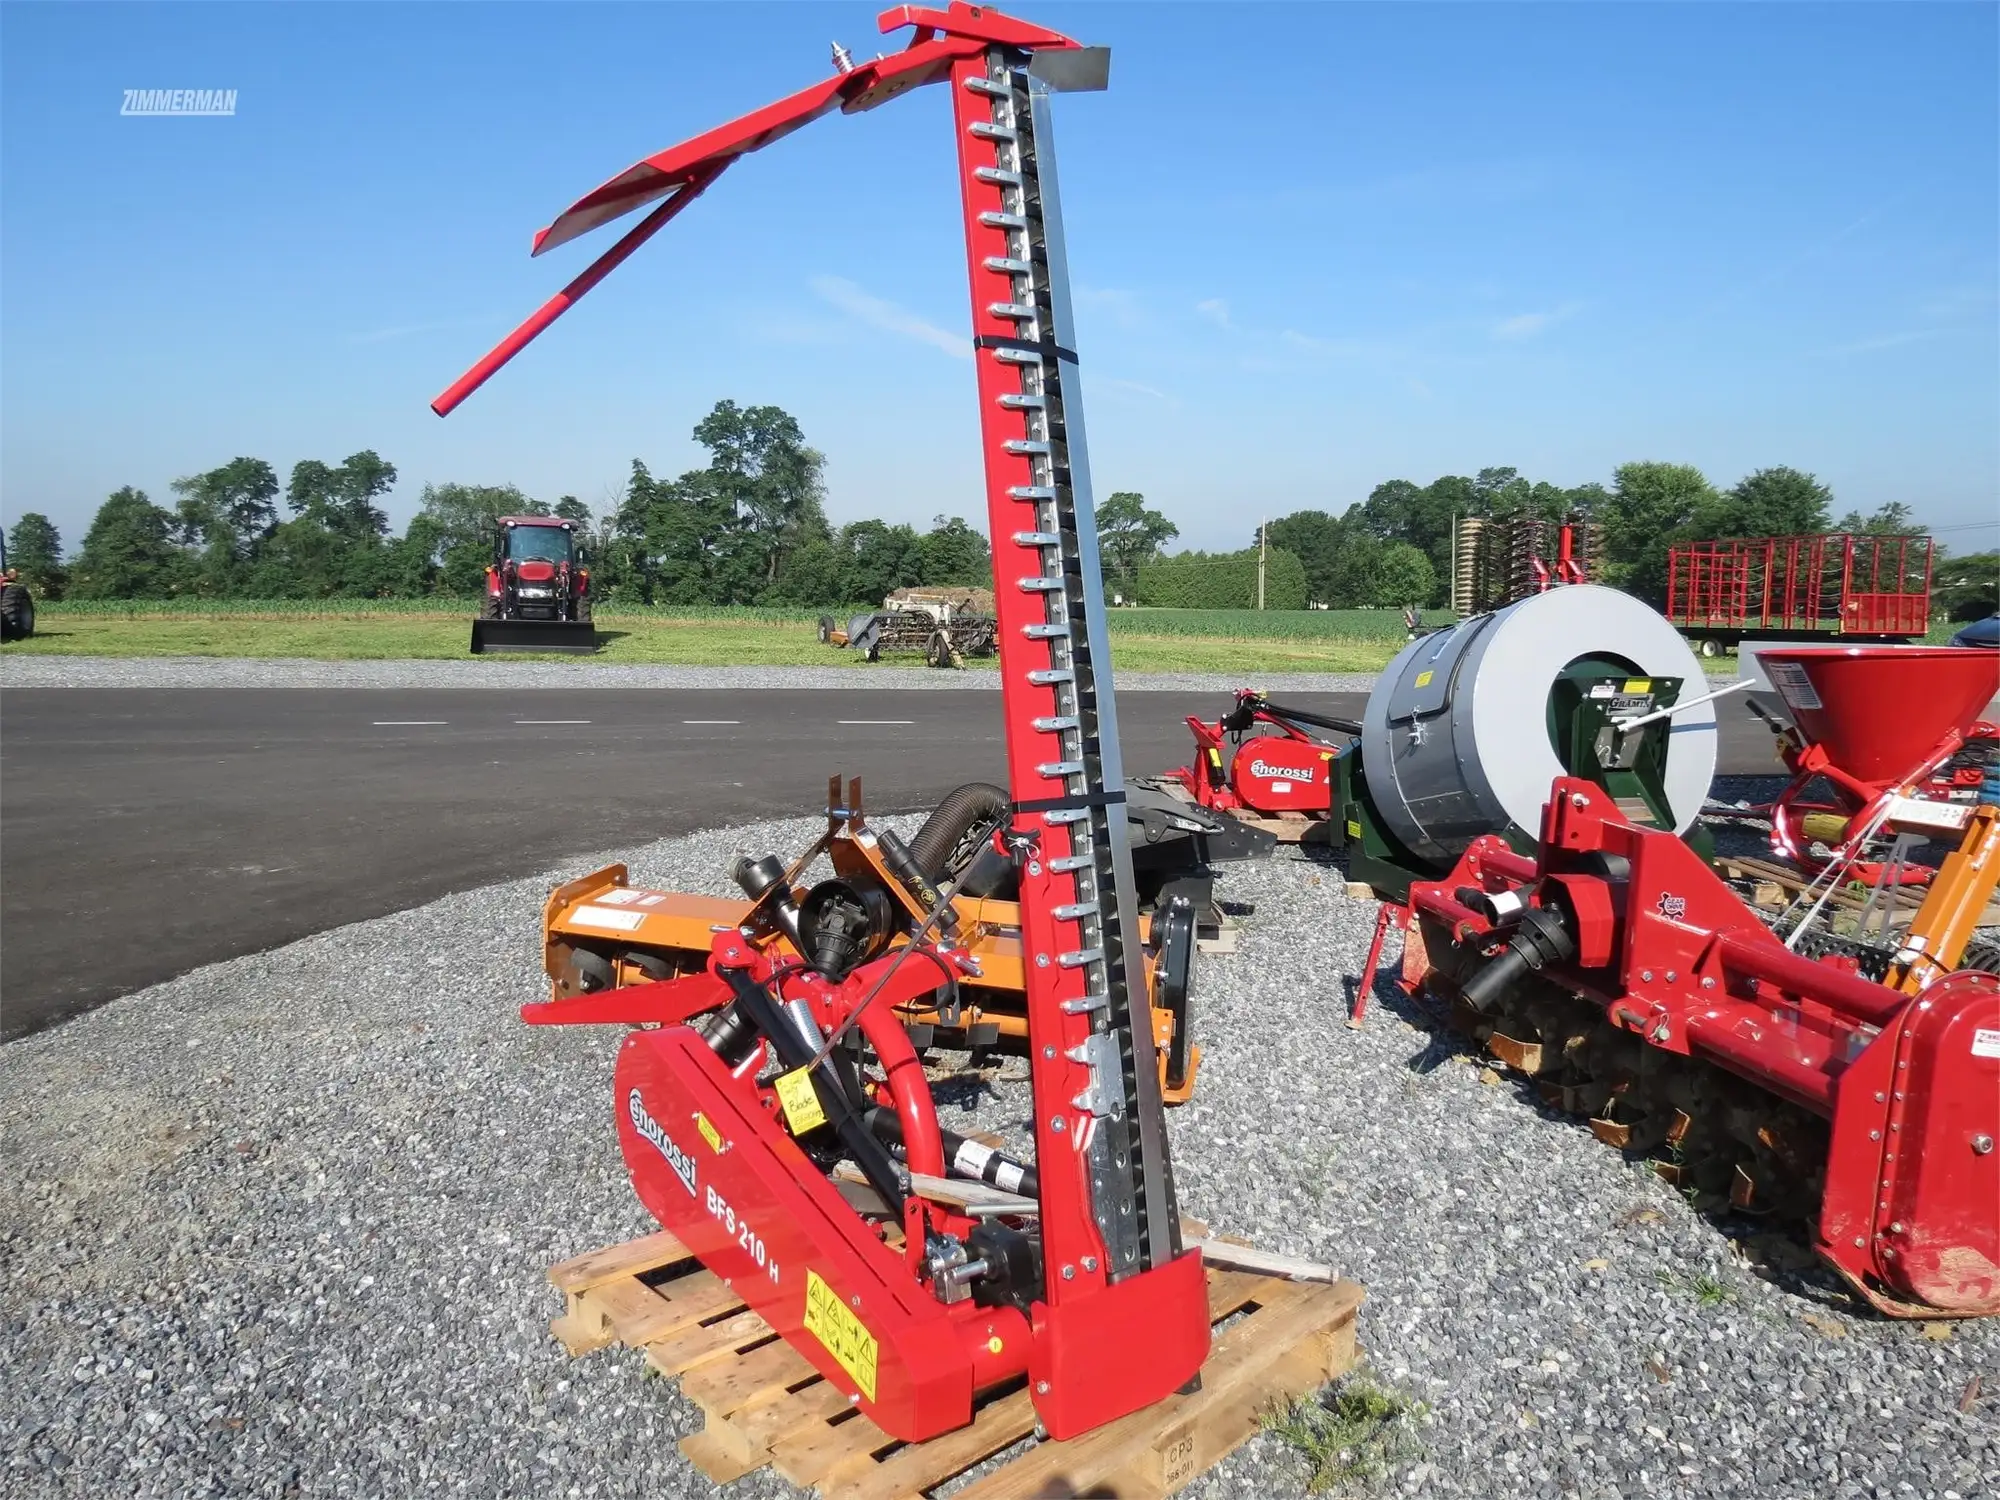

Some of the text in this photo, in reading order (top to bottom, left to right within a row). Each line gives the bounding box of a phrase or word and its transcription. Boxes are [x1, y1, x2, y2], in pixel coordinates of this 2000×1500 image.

[706, 1184, 736, 1235] BFS
[738, 1221, 766, 1267] 210
[769, 1258, 779, 1284] H
